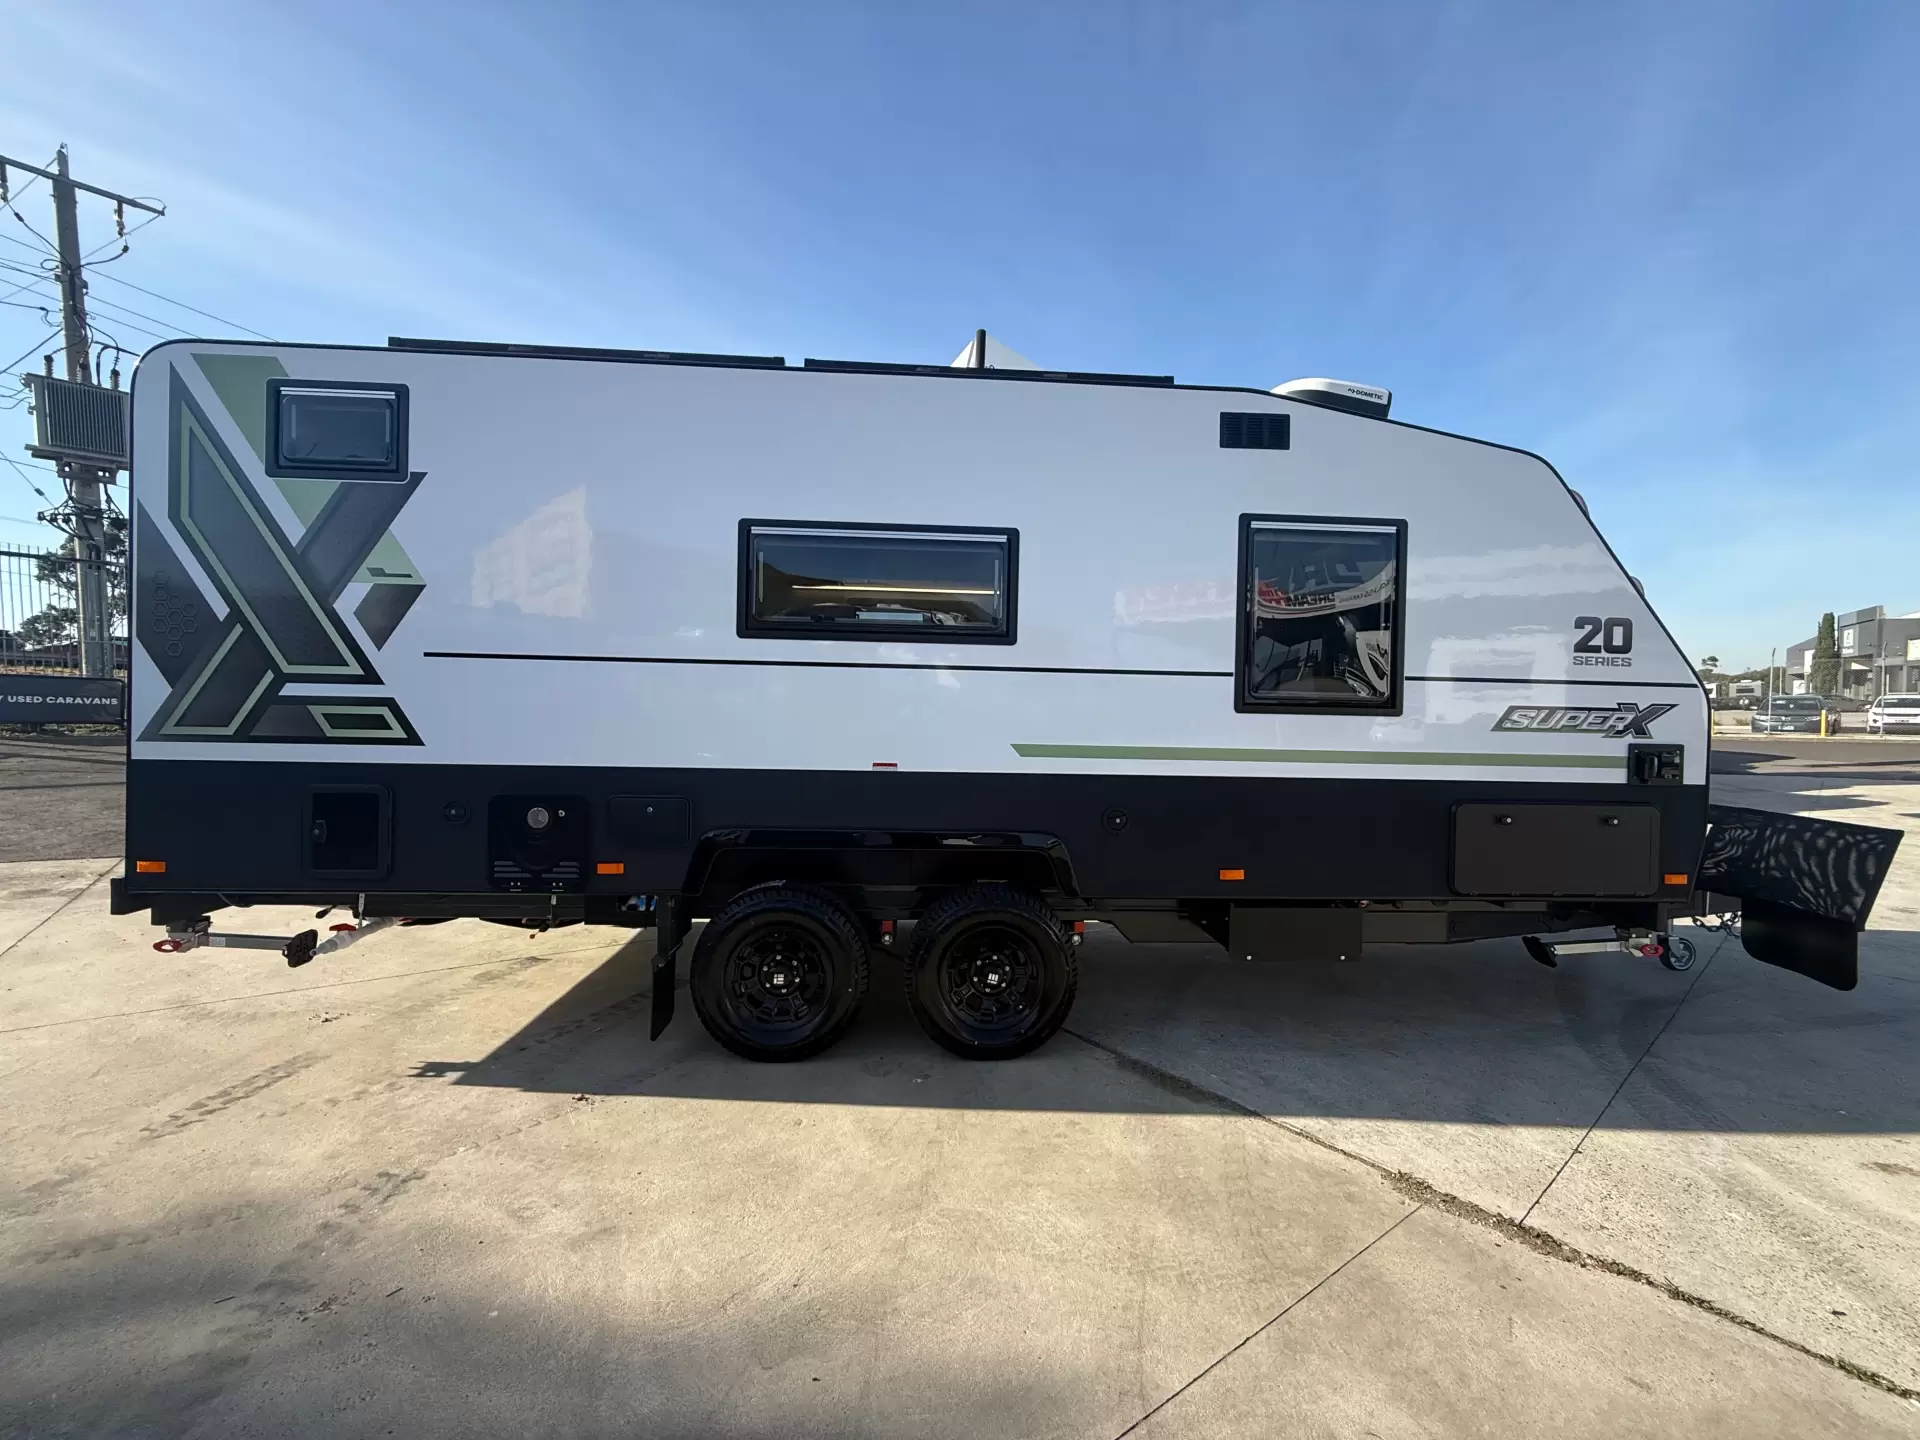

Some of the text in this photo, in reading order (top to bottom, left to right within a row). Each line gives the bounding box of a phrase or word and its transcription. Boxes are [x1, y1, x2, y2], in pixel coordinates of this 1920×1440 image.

[1356, 389, 1384, 401] DOMETIC
[1573, 616, 1633, 655] 20
[1572, 655, 1632, 667] SERIES
[7, 695, 43, 704] USED
[46, 696, 118, 705] CARAVANS
